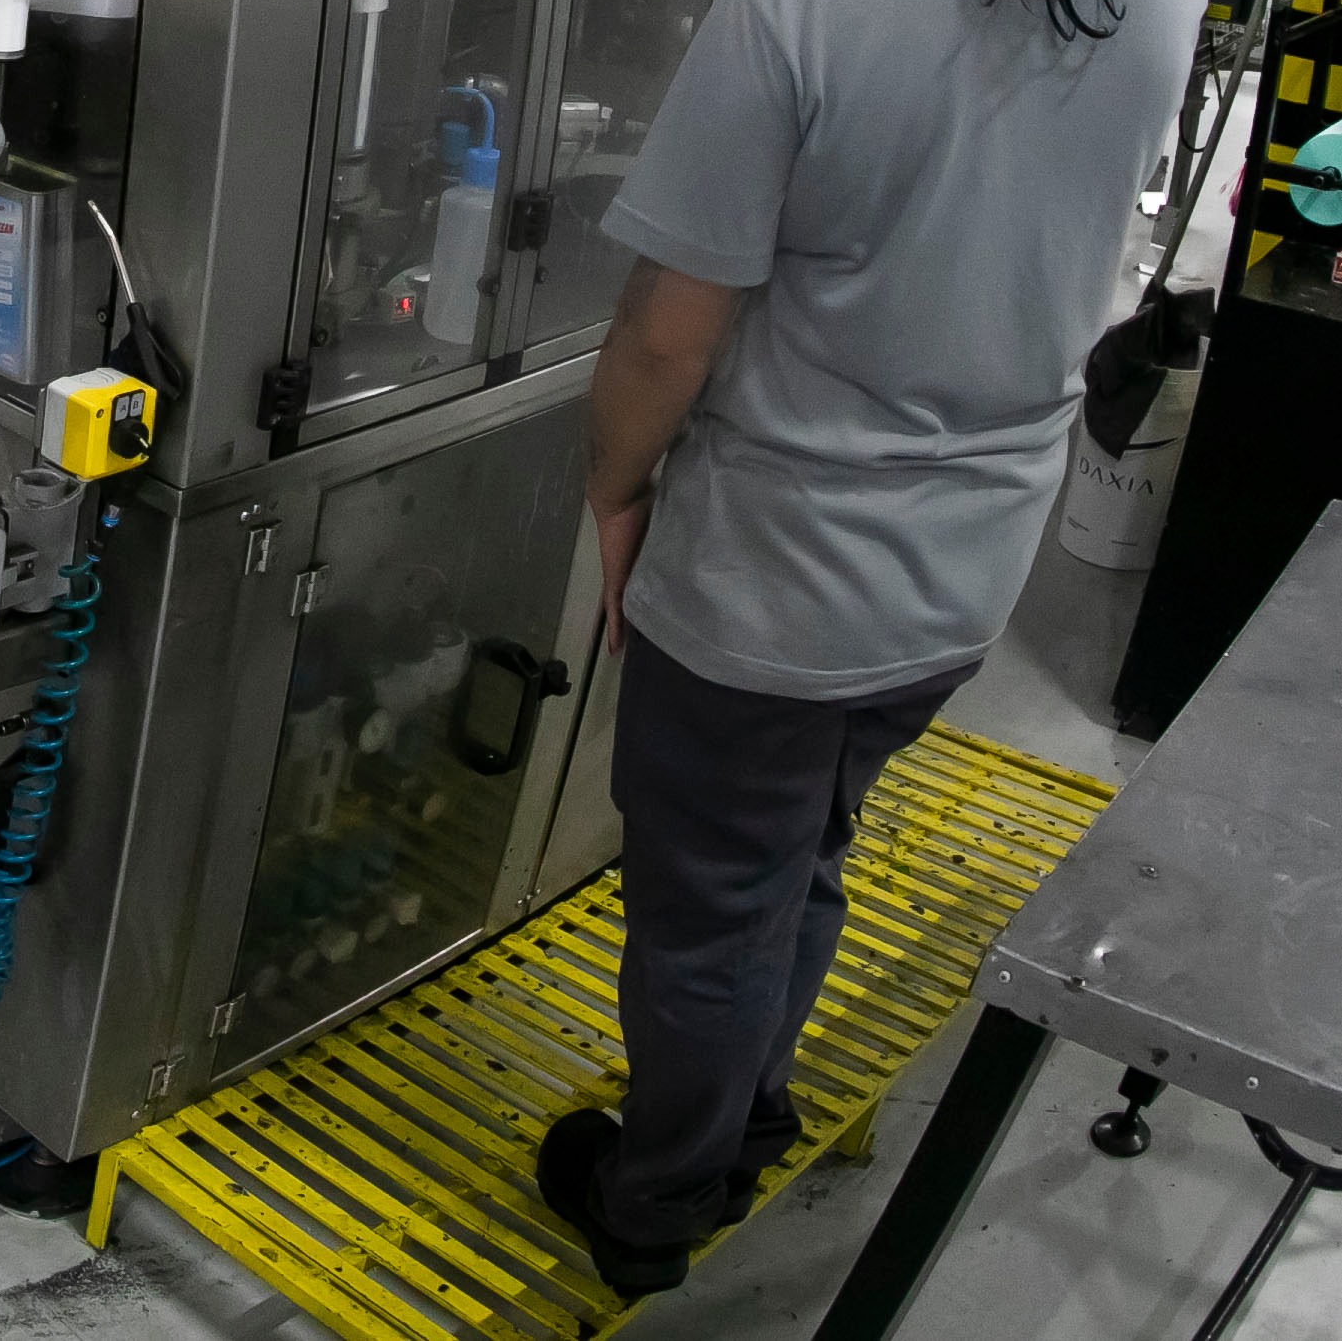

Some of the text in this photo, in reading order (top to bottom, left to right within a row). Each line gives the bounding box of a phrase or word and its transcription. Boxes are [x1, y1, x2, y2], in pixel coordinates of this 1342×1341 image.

[120, 401, 139, 413] A B
[1079, 456, 1154, 496] DAXIA
